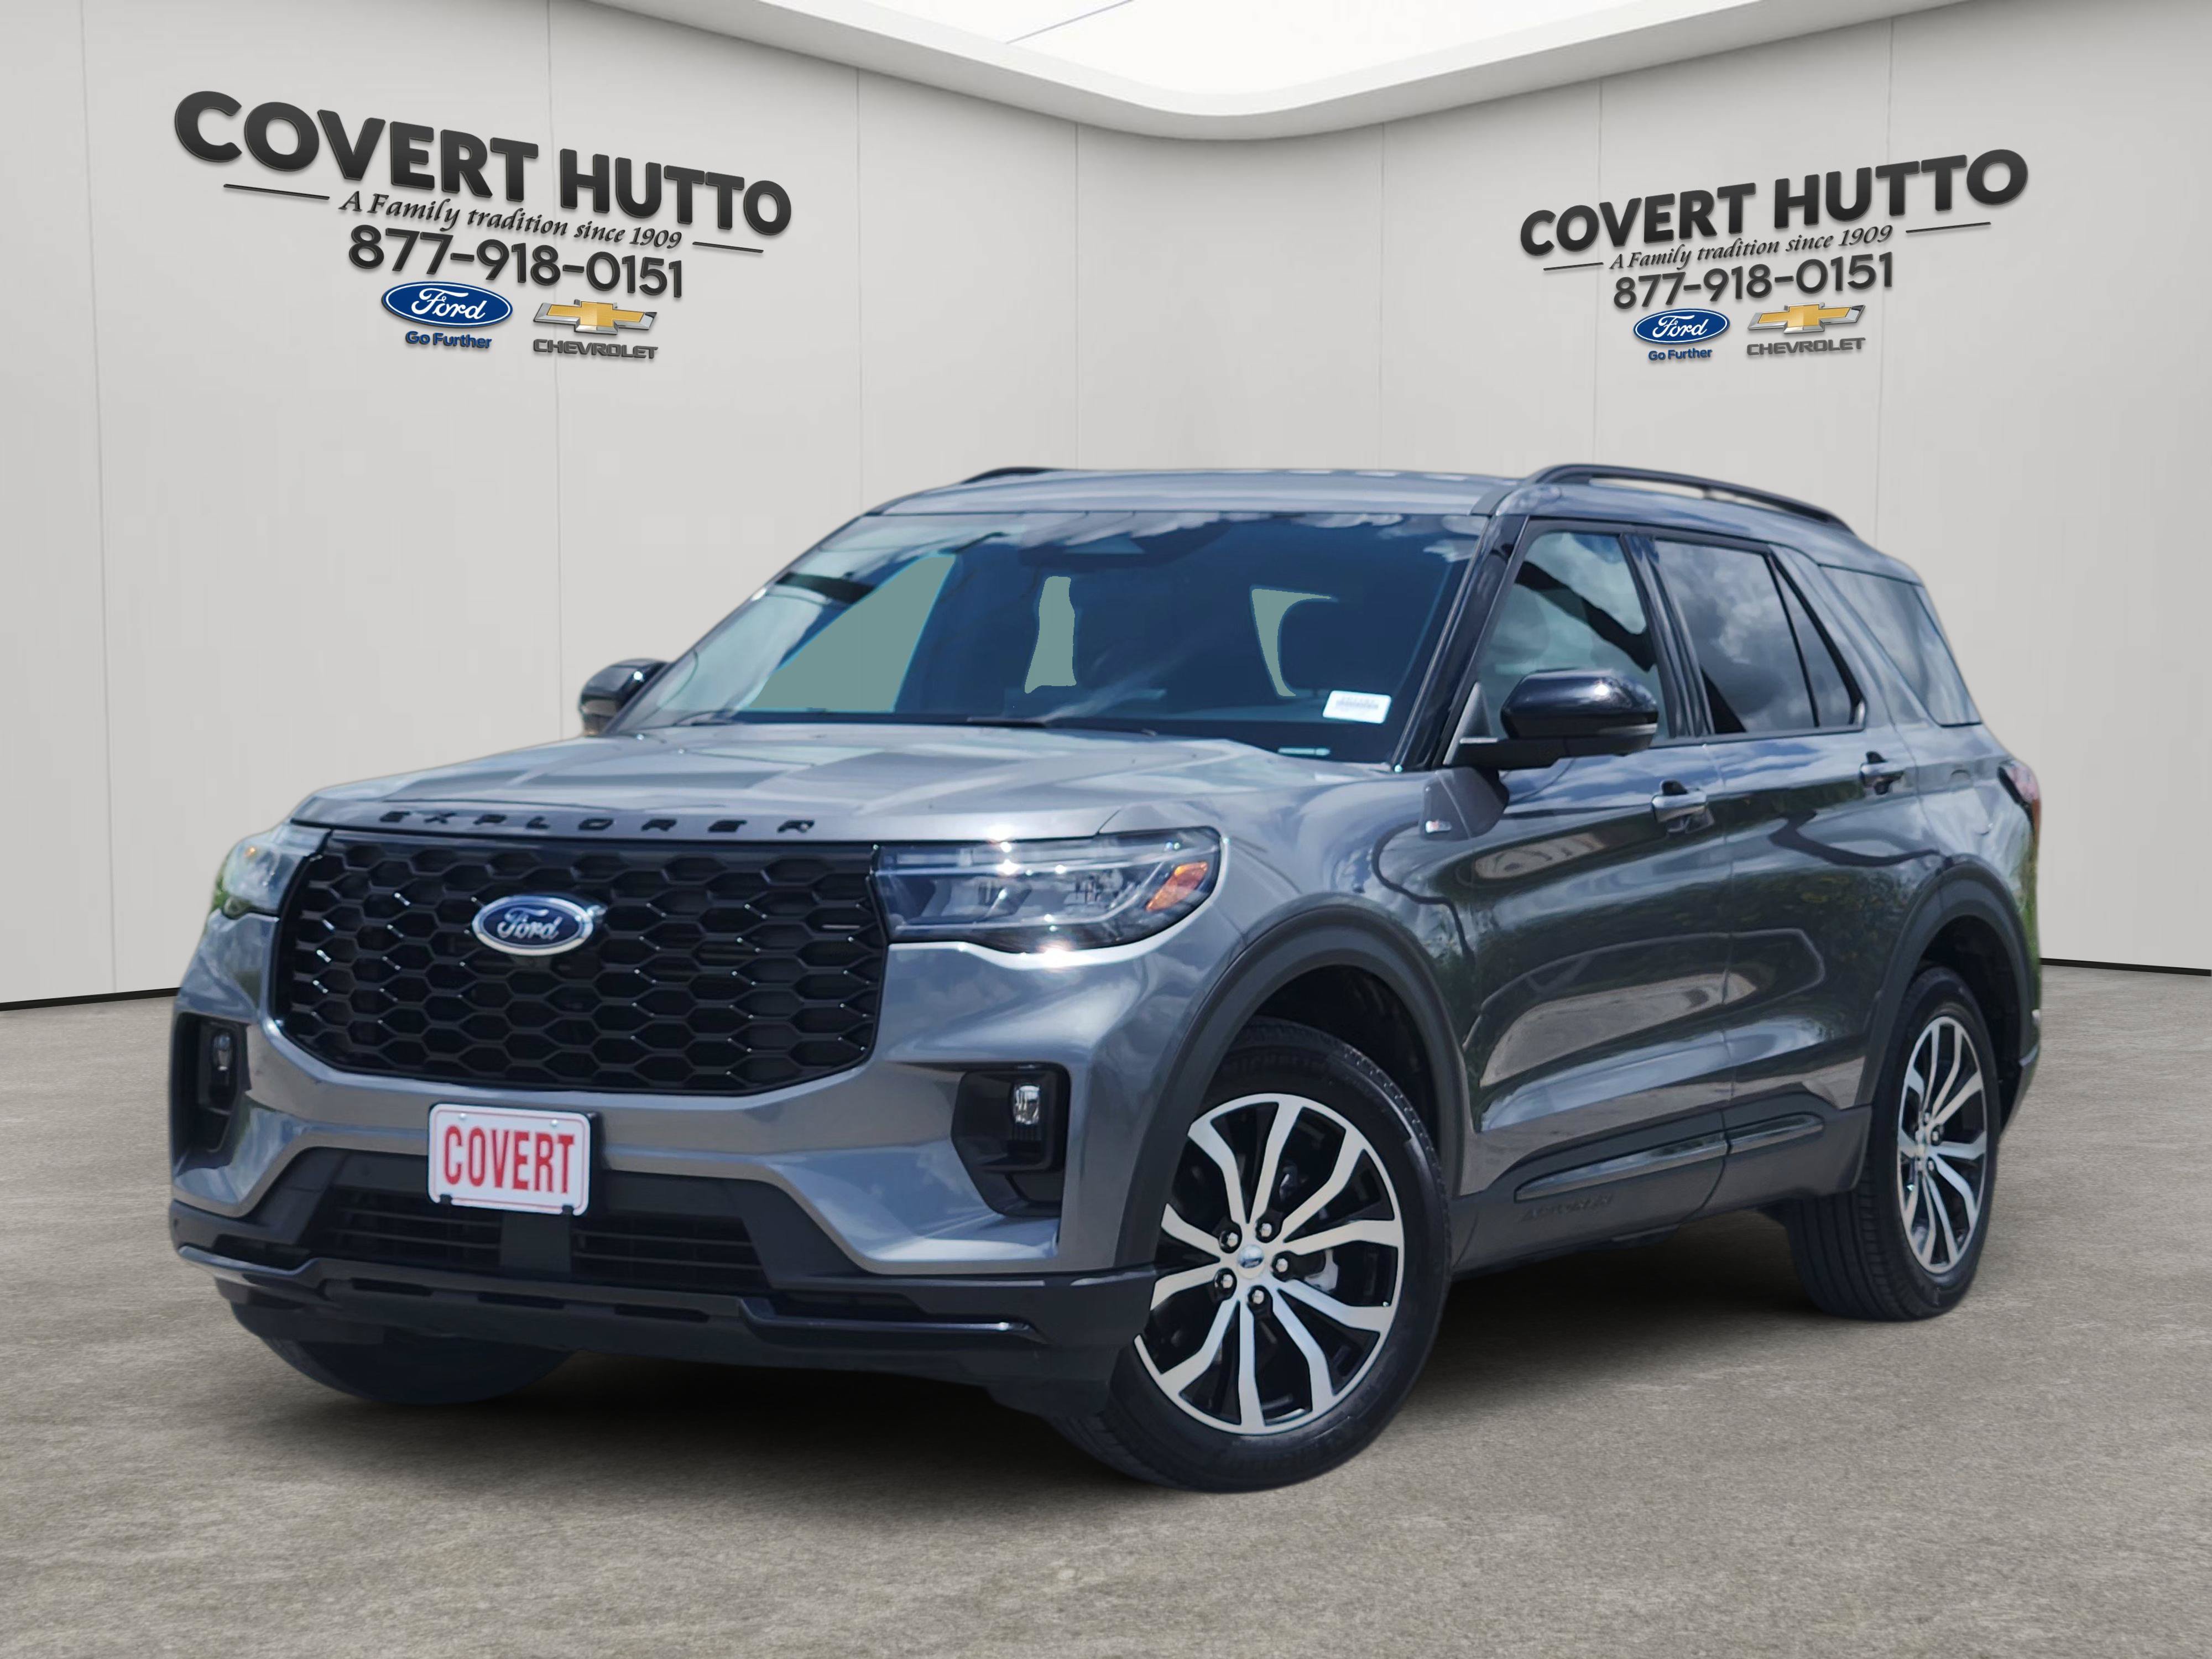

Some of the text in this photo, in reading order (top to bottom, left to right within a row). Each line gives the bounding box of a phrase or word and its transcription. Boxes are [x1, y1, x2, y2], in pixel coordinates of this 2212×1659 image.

[175, 90, 791, 236] COVERT HUTTO
[1520, 149, 2028, 255] COVERT HUTTO
[340, 190, 682, 251] A Family tradition since 1909
[348, 225, 682, 297] 877-918-0151
[1609, 225, 1893, 270] A Family tradition since 1909
[1613, 251, 1892, 309] 877-918-0151
[411, 287, 487, 321] Ford
[405, 331, 492, 349] Go Further
[1653, 314, 1708, 337] Ford
[533, 338, 658, 359] CHEVROLET
[1648, 347, 1713, 360] Go Further
[1747, 337, 1866, 355] CHEVROLET
[379, 811, 816, 833] EXPLORER
[497, 907, 560, 941] Ford
[444, 1125, 575, 1193] COVERT
